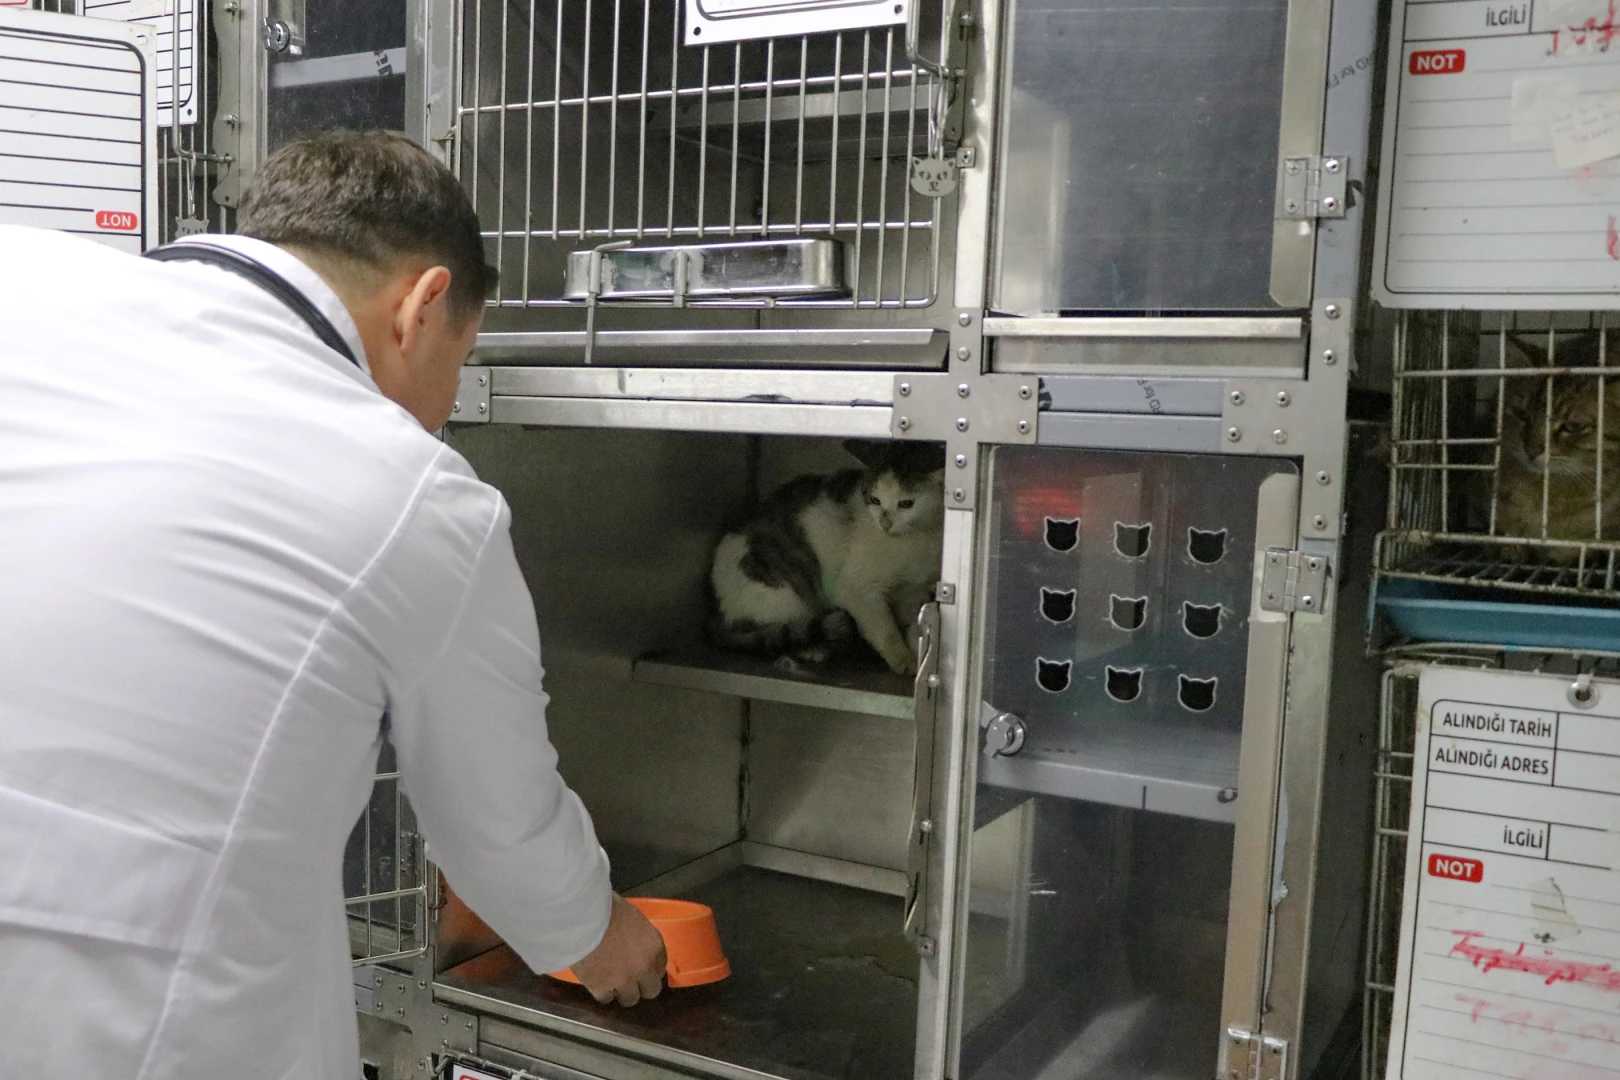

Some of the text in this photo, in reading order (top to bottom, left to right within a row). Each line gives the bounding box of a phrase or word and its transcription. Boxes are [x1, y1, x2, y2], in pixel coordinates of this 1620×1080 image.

[1485, 4, 1527, 27] İLGİLİ
[1416, 54, 1458, 71] NOT
[101, 213, 132, 227] NOT
[1443, 711, 1552, 738] ALINDIĞI TARİH
[1501, 755, 1549, 775] ADRES
[1503, 824, 1544, 849] İLGİLİ
[1435, 858, 1476, 878] NOT
